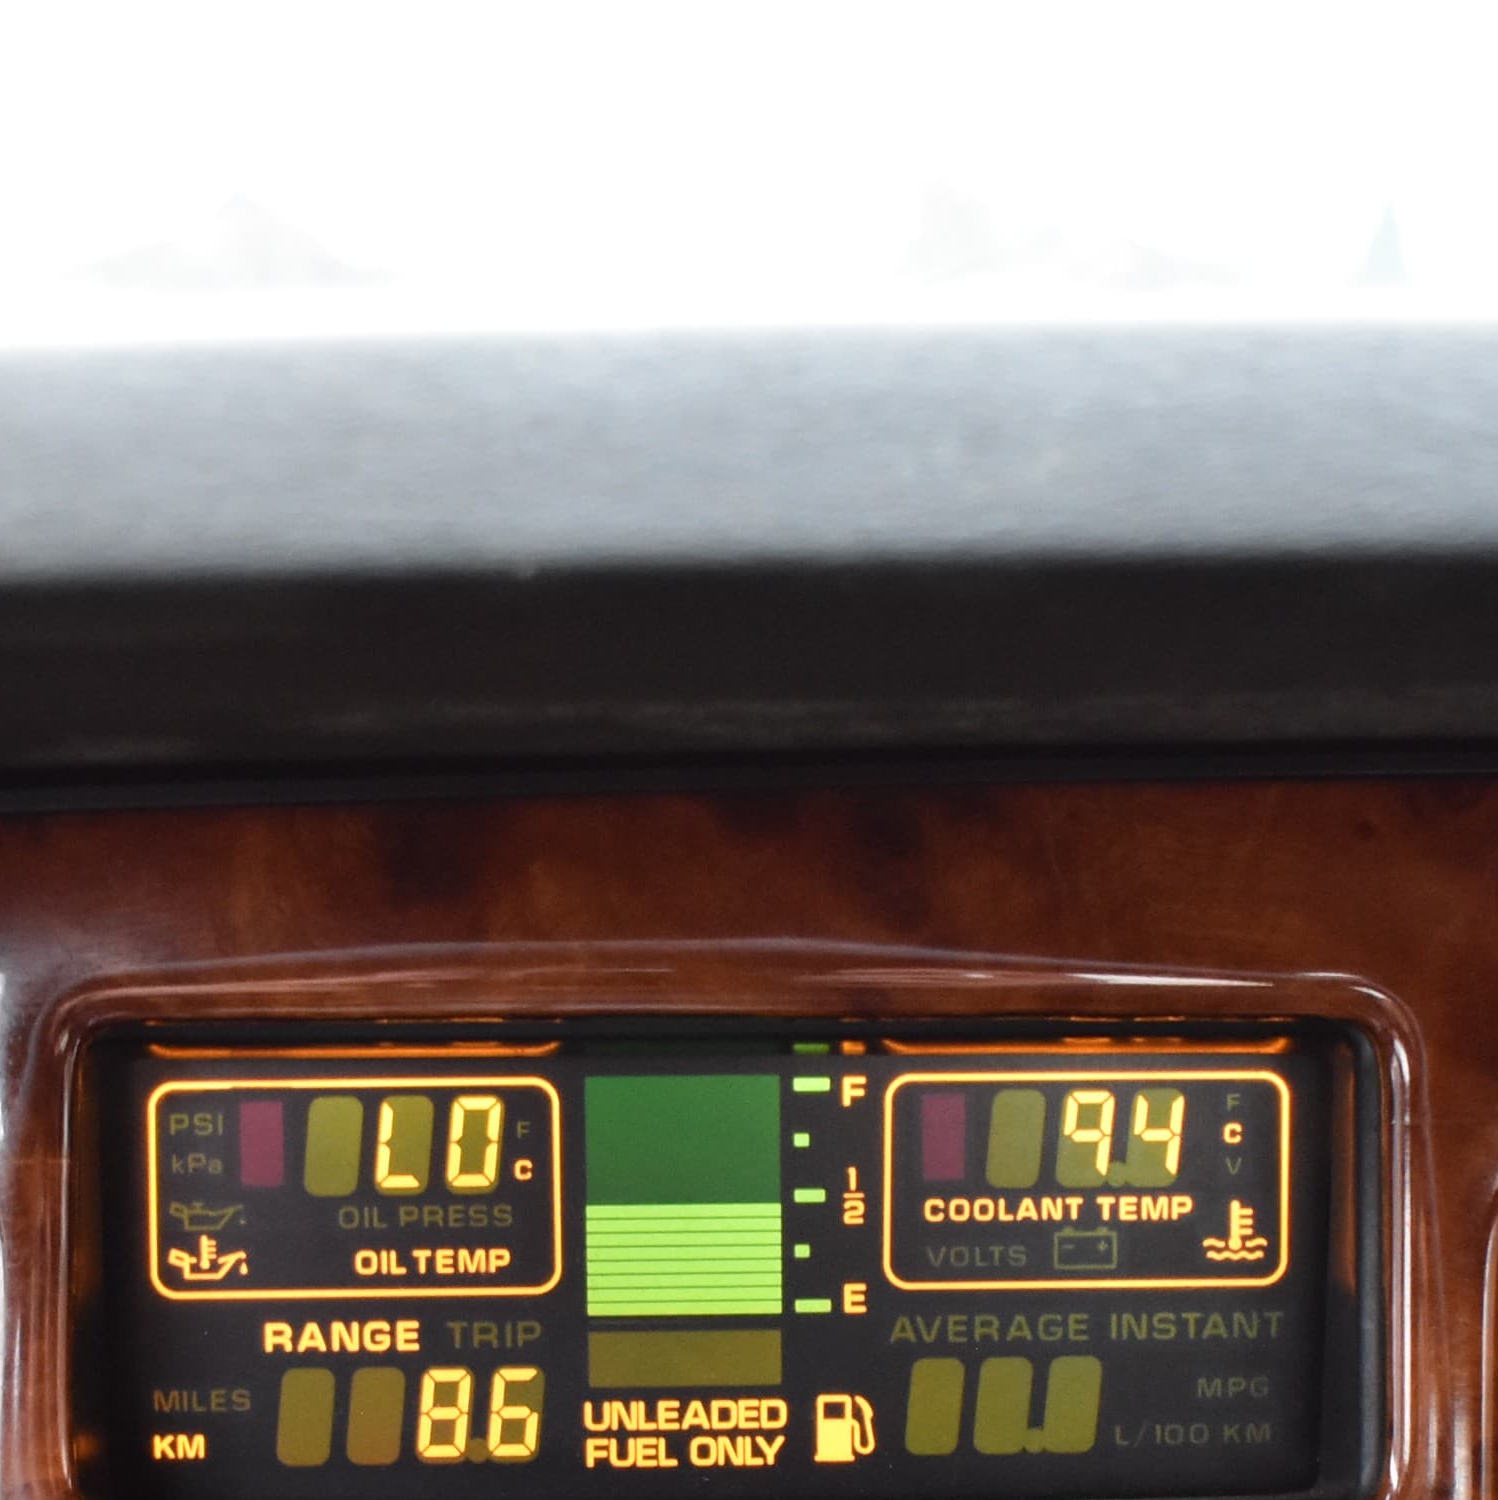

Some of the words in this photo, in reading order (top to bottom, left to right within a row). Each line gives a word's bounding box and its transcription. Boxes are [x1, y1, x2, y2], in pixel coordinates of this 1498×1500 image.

[842, 1076, 867, 1107] F
[1227, 1093, 1241, 1110] F
[169, 1113, 225, 1135] PSI
[516, 1121, 530, 1139] F
[1064, 1091, 1185, 1175] 94
[1223, 1124, 1243, 1143] C
[173, 1154, 223, 1174] kPa
[513, 1160, 533, 1180] C
[1225, 1158, 1242, 1175] V
[339, 1207, 387, 1228] OIL
[400, 1205, 513, 1227] PRESS
[924, 1198, 1084, 1221] COOLANT
[1096, 1196, 1193, 1220] TEMP
[354, 1250, 407, 1275] OIL
[412, 1250, 511, 1274] TEMP
[927, 1246, 1027, 1267] VOLTS
[843, 1283, 867, 1314] E
[264, 1321, 421, 1352] RANGE
[447, 1321, 541, 1348] TRIP
[890, 1314, 1089, 1342] AVERAGE
[1111, 1312, 1284, 1340] INSTANT
[1198, 1378, 1270, 1397] MPG
[154, 1390, 251, 1411] MILES
[417, 1368, 539, 1457] 86
[584, 1399, 788, 1431] UNLEADED
[1115, 1424, 1210, 1446] L/100
[1224, 1424, 1271, 1442] KM
[153, 1435, 205, 1460] KM
[585, 1439, 678, 1468] FUEL
[690, 1435, 785, 1467] ONLY
